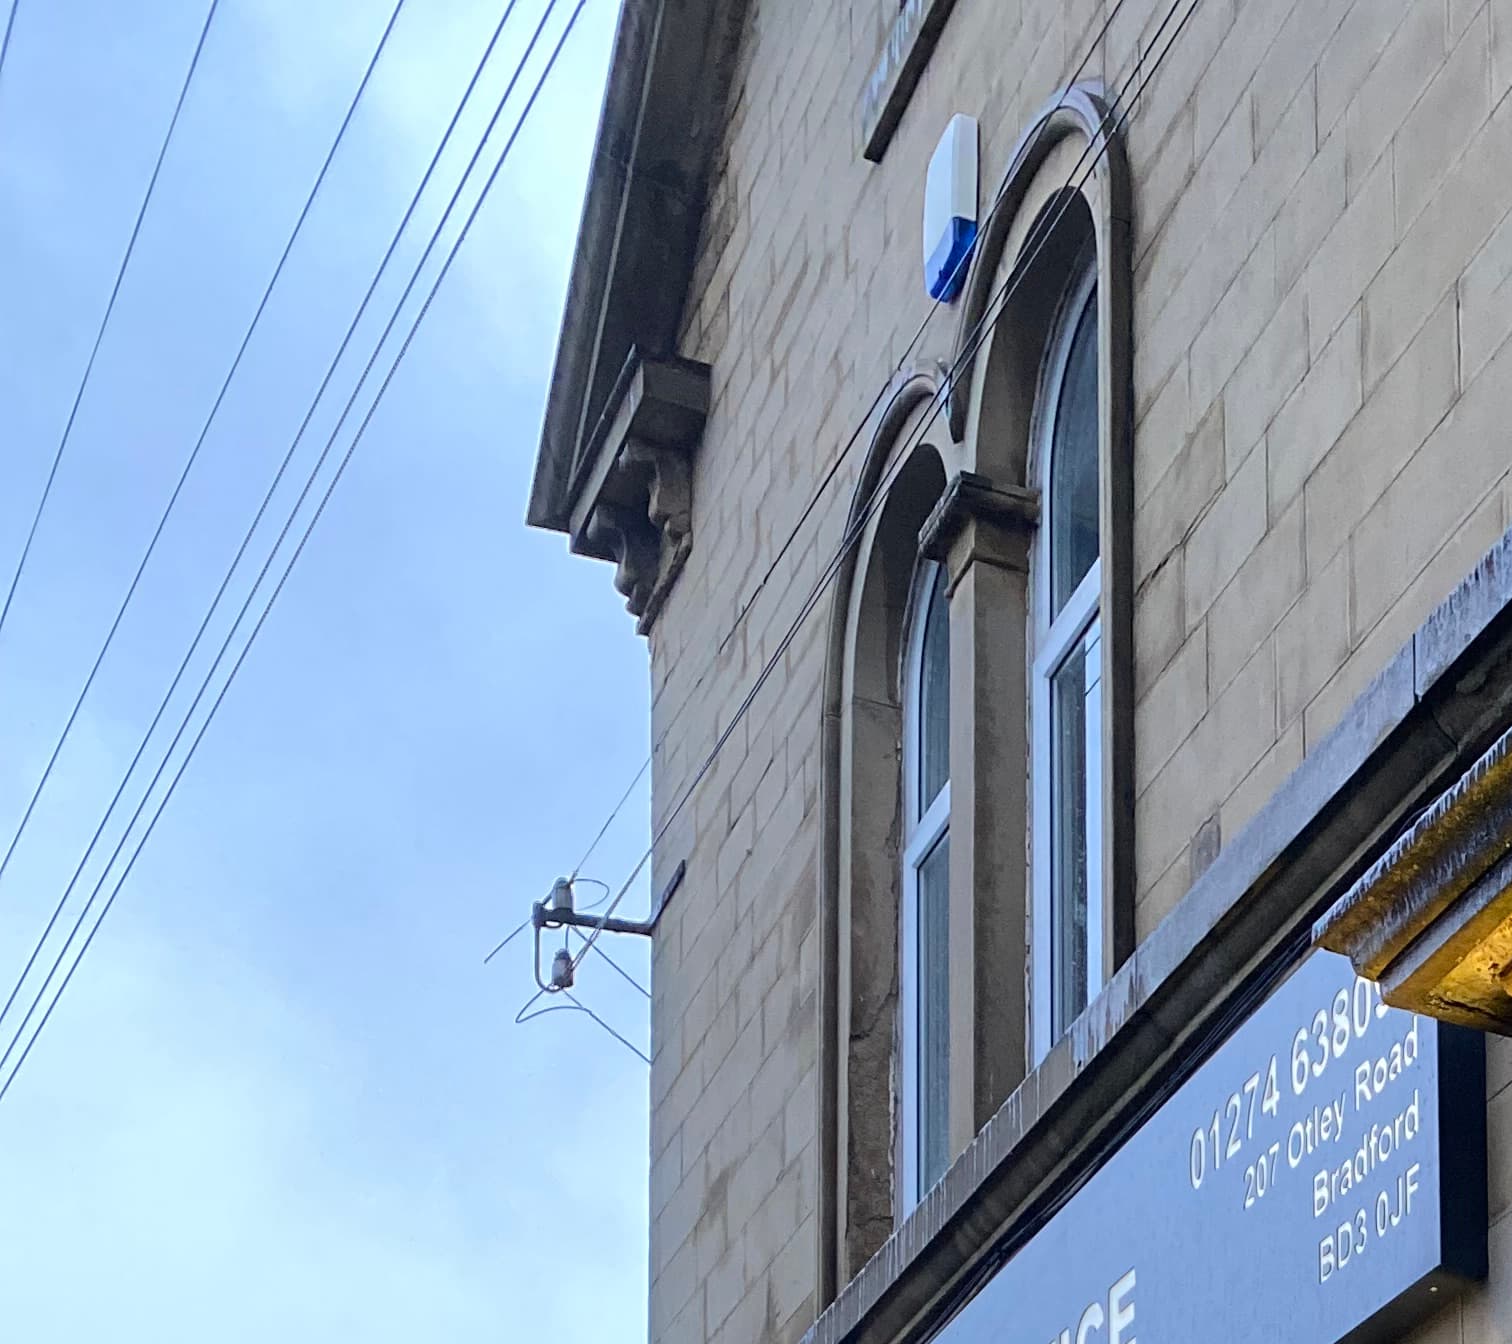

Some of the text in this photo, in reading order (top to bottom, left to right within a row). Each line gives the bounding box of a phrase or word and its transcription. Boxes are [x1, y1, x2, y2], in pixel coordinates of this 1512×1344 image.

[1189, 1054, 1281, 1190] 01274
[1243, 1015, 1418, 1210] 207 Otley Road
[1312, 1089, 1419, 1218] Bradford
[1318, 1207, 1367, 1285] BD3
